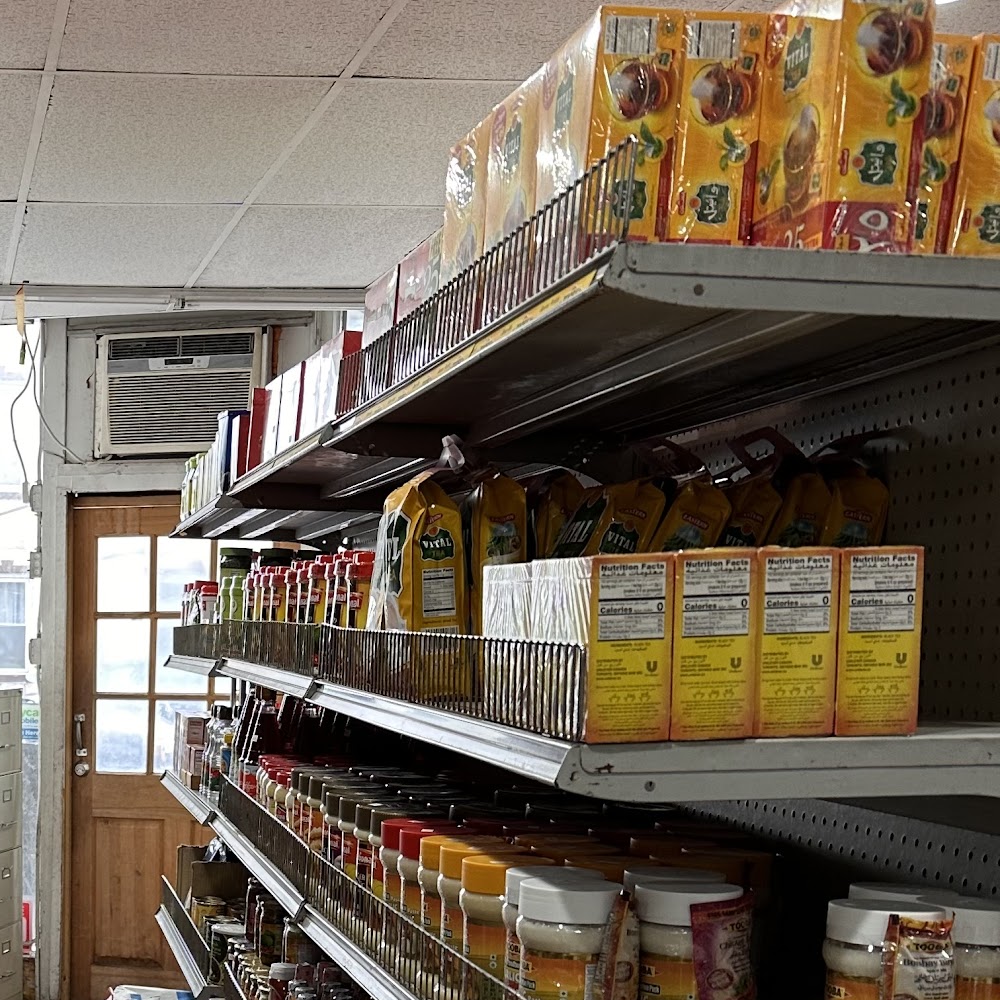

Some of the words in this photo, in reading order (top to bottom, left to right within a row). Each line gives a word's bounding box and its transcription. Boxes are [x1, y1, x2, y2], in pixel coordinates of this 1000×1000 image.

[422, 537, 452, 549] VITAL
[607, 531, 636, 552] VITAL
[767, 557, 805, 565] Nutrition
[853, 555, 890, 563] Nutrition
[892, 554, 916, 562] Facts
[601, 564, 639, 572] Nutrition
[686, 560, 723, 568] Nutrition
[822, 596, 829, 605] 0
[907, 594, 914, 604] 0
[600, 606, 633, 614] Calories
[656, 602, 664, 612] 0
[741, 599, 748, 609] 0
